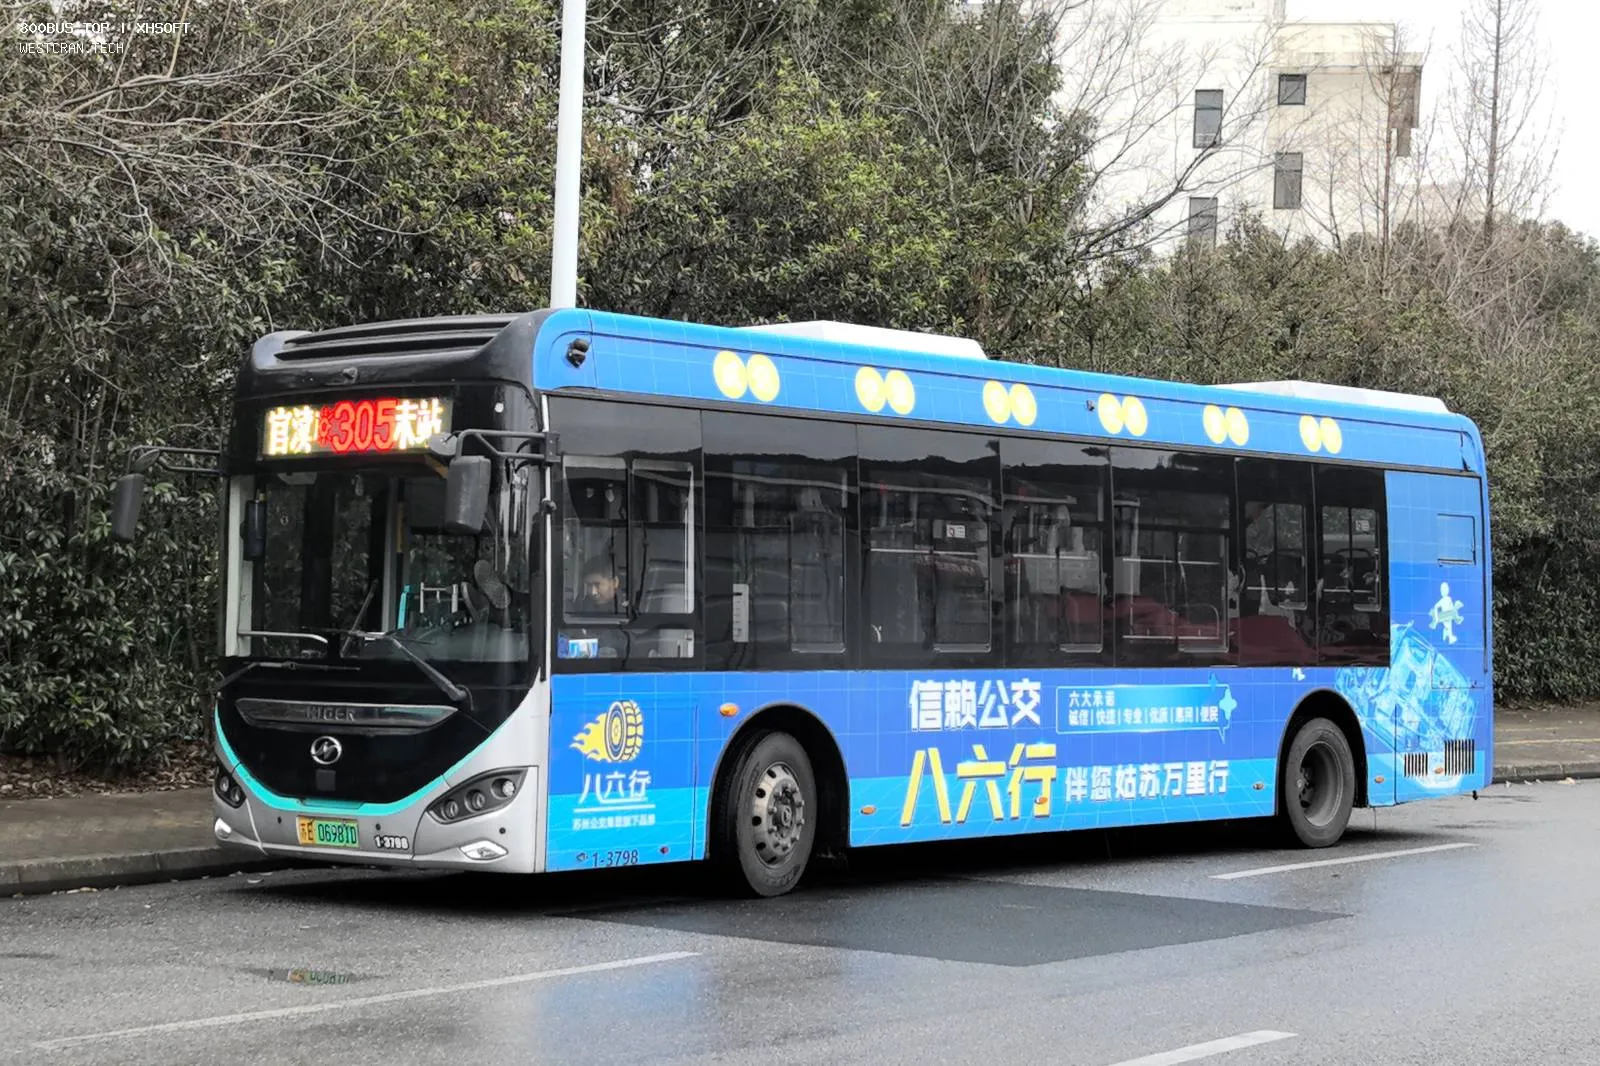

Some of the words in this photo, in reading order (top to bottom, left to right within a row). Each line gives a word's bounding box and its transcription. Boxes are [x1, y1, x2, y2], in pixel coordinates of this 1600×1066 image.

[332, 400, 397, 453] 305
[909, 678, 1042, 732] 信赖公交
[578, 769, 652, 805] 八六行
[900, 743, 1057, 826] 八六行
[1065, 760, 1230, 802] 伴您姑苏万里行
[592, 850, 639, 868] 1-3798
